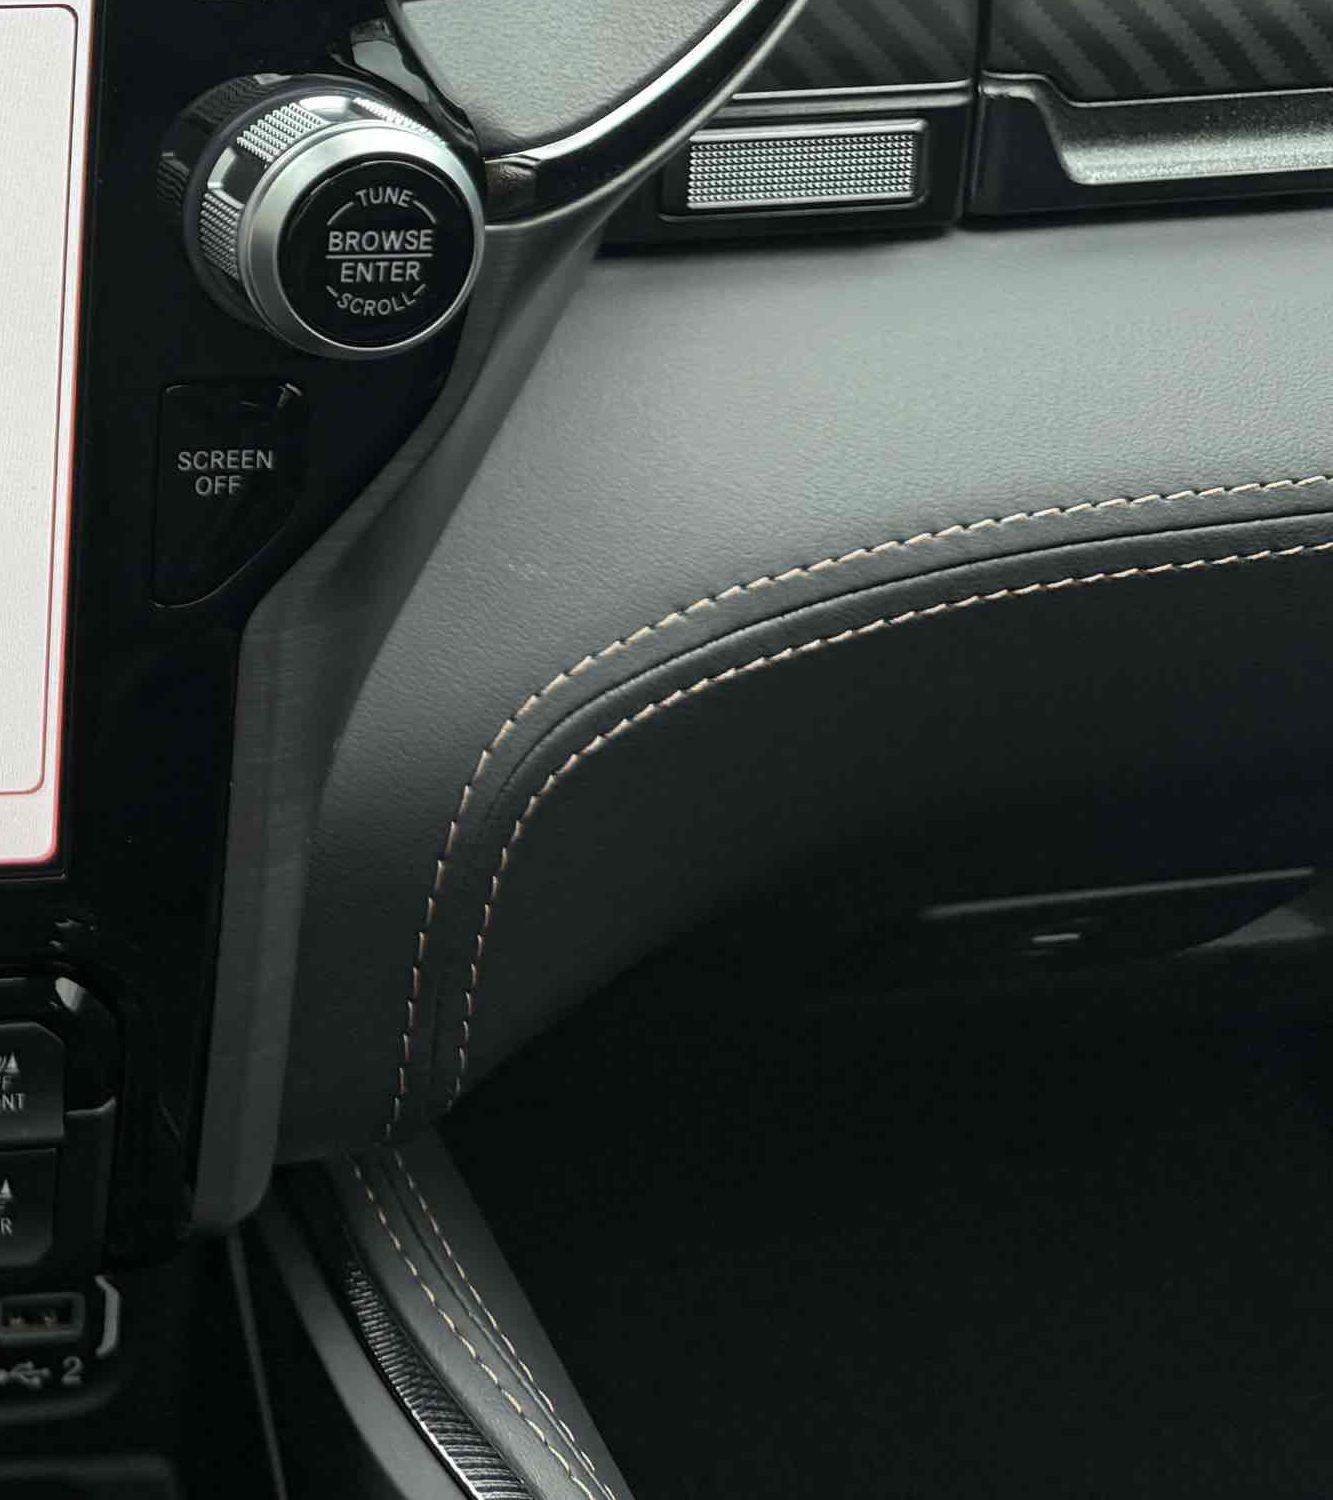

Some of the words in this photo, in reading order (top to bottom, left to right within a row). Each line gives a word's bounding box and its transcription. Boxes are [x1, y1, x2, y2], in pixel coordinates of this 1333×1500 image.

[355, 187, 414, 208] TUNE
[328, 229, 433, 252] BROWSE
[340, 261, 421, 283] ENTER
[337, 291, 417, 317] SCROLL
[178, 450, 273, 471] SCREEN
[195, 475, 241, 496] OFF
[62, 1357, 83, 1383] 2
